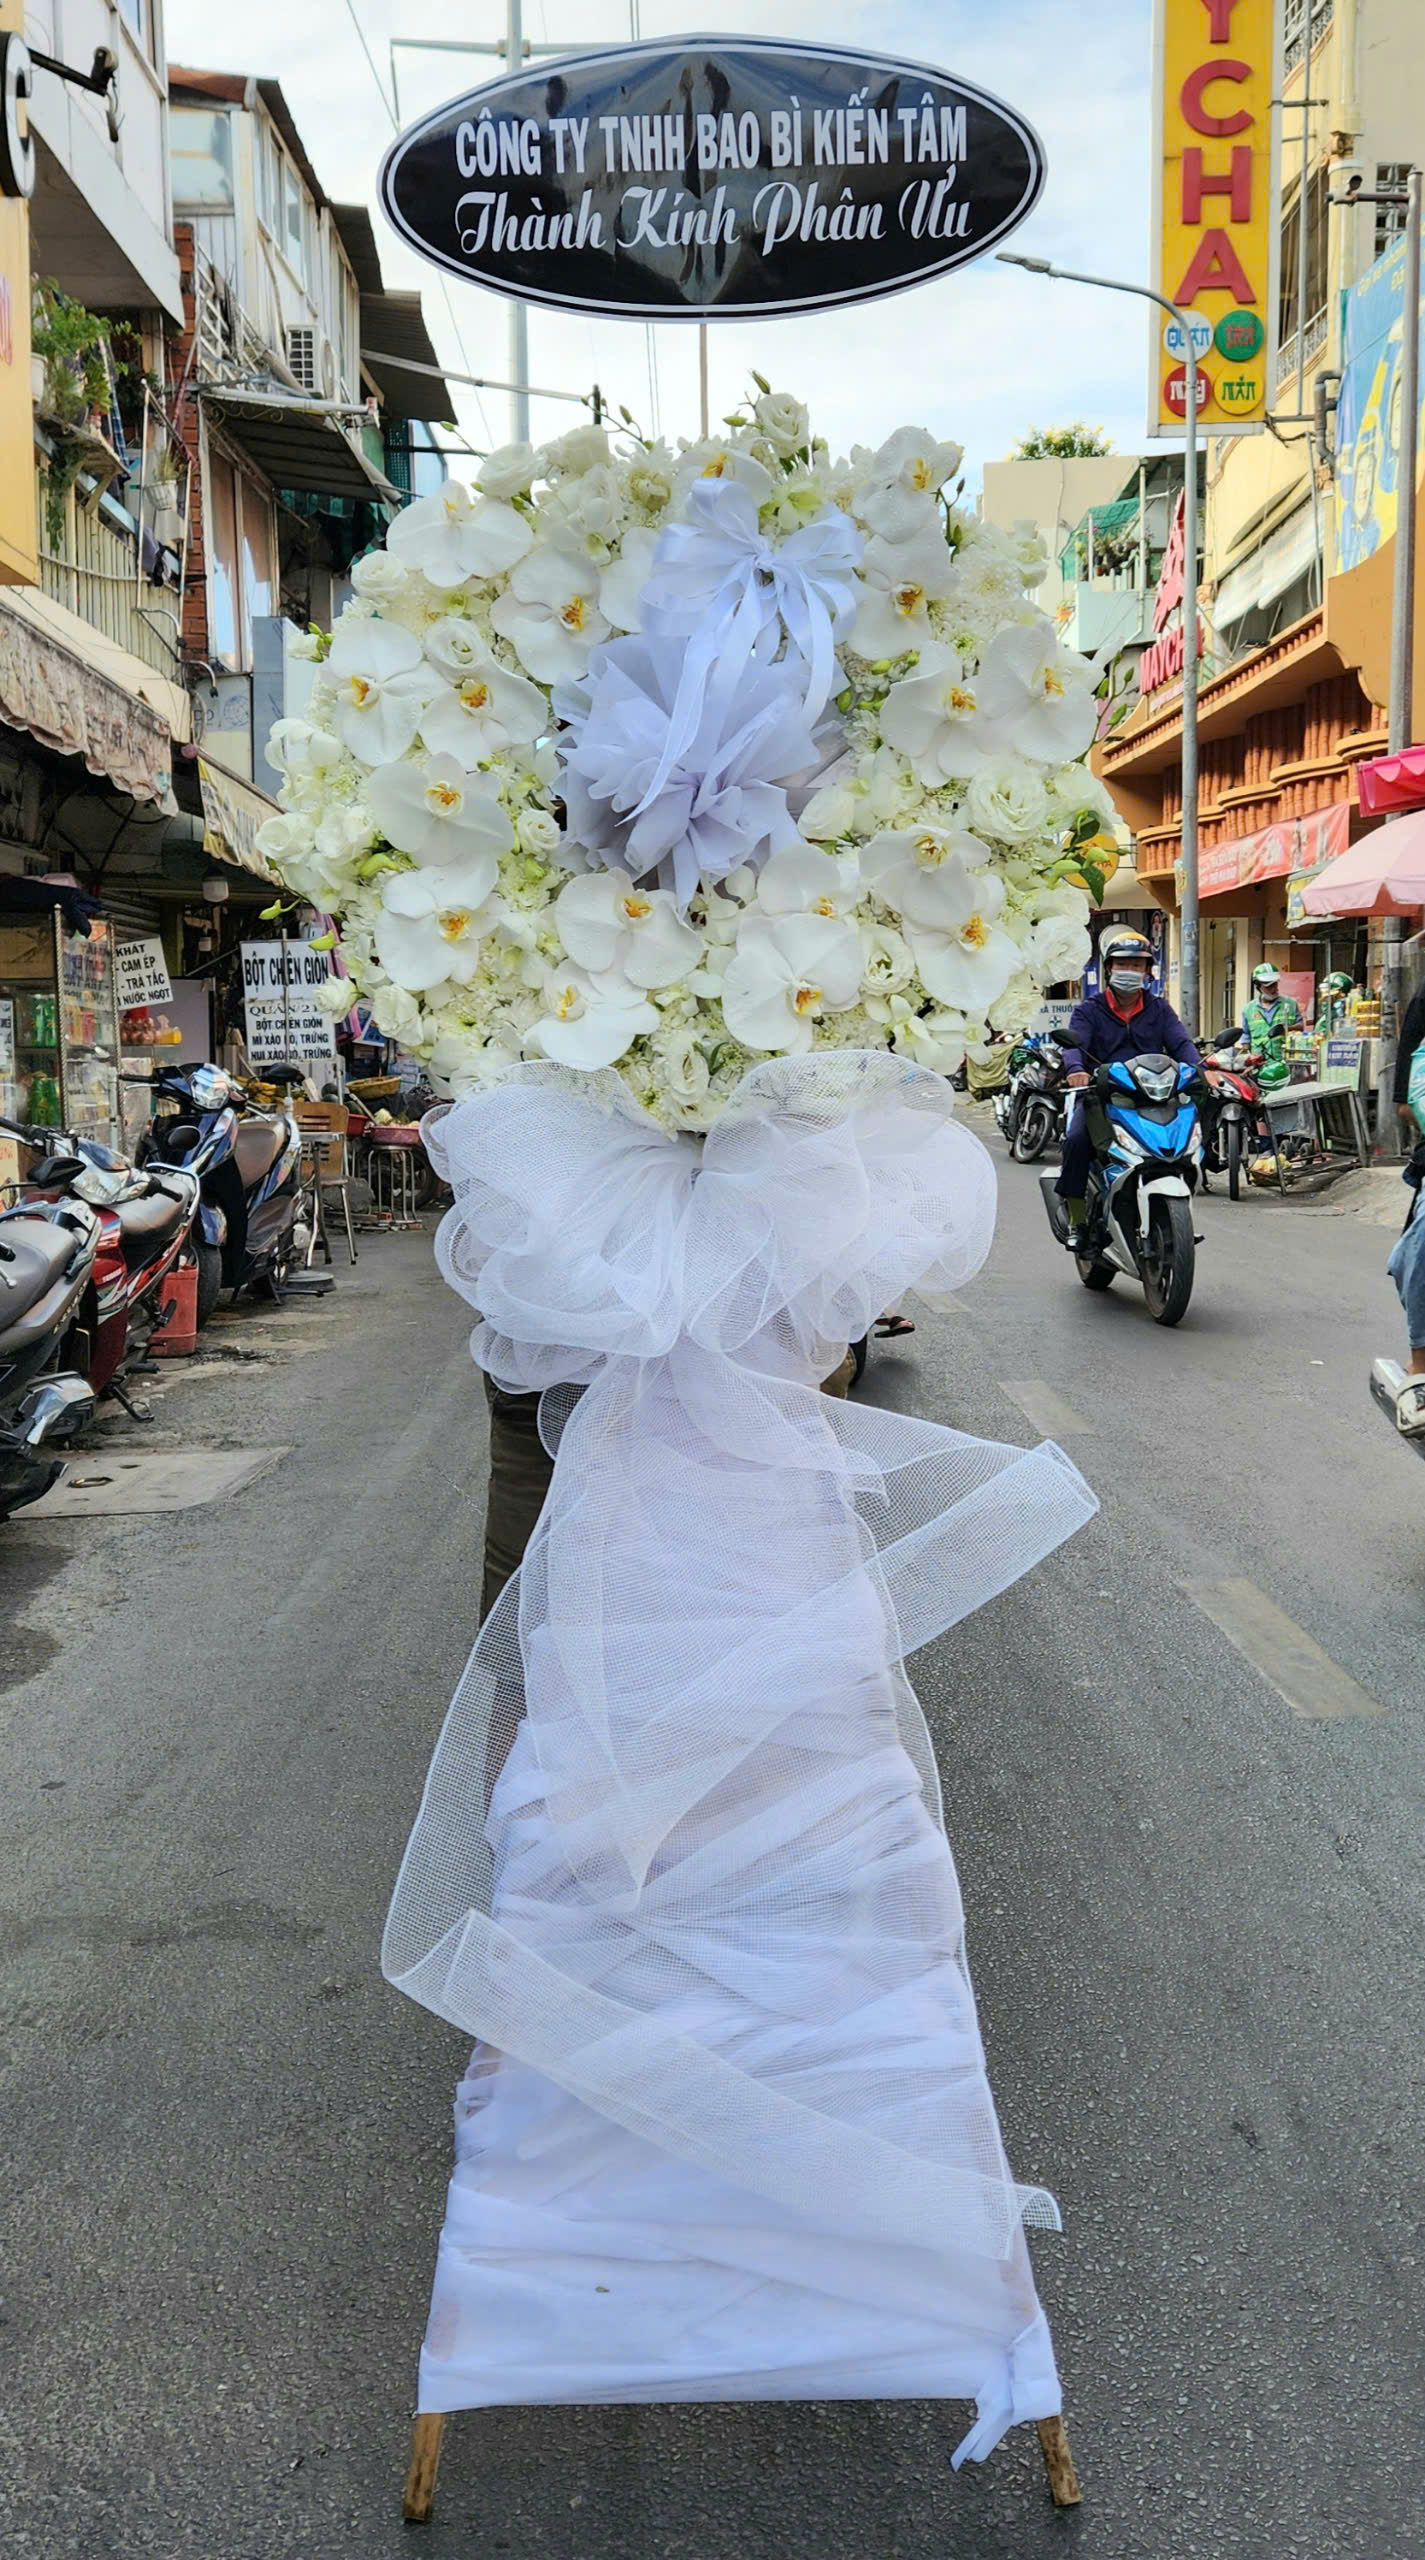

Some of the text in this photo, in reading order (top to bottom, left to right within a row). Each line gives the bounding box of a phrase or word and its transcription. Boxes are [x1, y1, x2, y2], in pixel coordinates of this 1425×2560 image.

[456, 87, 967, 178] CÔNG TY TNHH BAO BÌ KIẾN TÂM
[455, 164, 973, 257] Thành Kính Phân Ưu
[121, 958, 142, 973] CAM
[243, 950, 266, 992] BỘT
[269, 950, 302, 986] CHÊN
[275, 1016, 300, 1029] CHÊN
